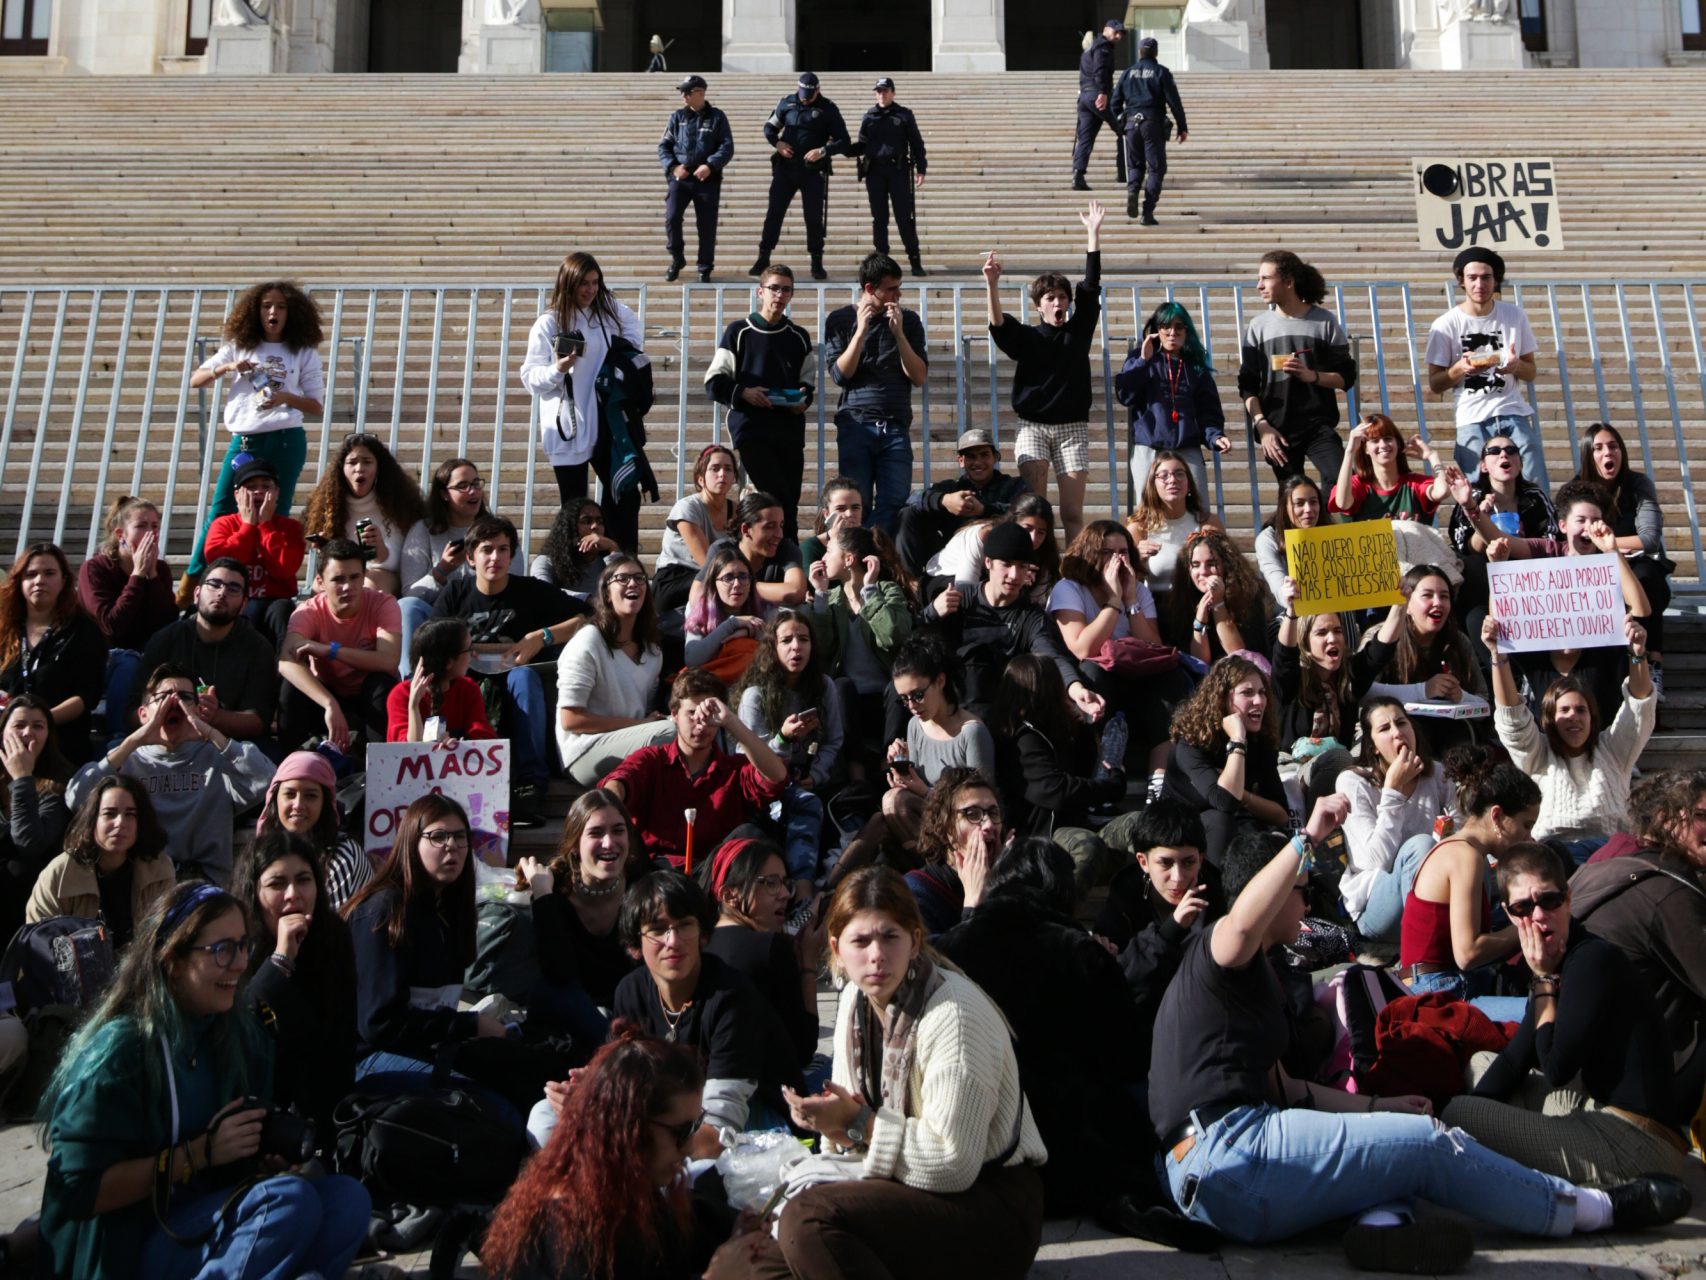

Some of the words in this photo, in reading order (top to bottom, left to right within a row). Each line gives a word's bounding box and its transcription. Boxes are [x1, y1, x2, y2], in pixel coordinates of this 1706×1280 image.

[1293, 541, 1317, 562] NÃO
[1321, 537, 1354, 559] QUERO
[1295, 560, 1318, 581] NÃO
[1322, 557, 1357, 578] GOSTO
[1359, 554, 1372, 573] DE
[1491, 571, 1545, 594] ESTAMOS
[1548, 568, 1573, 590] AQUI
[1575, 565, 1617, 588] PORQUE
[1299, 579, 1321, 601] MAS
[1495, 595, 1519, 617] NÃO
[1521, 595, 1545, 616] NOS
[1596, 589, 1613, 610] OU
[1497, 619, 1521, 641] NÃO
[1523, 617, 1575, 640] QUEREM
[1577, 614, 1615, 636] OUVIR!
[396, 741, 504, 785] MÃOS
